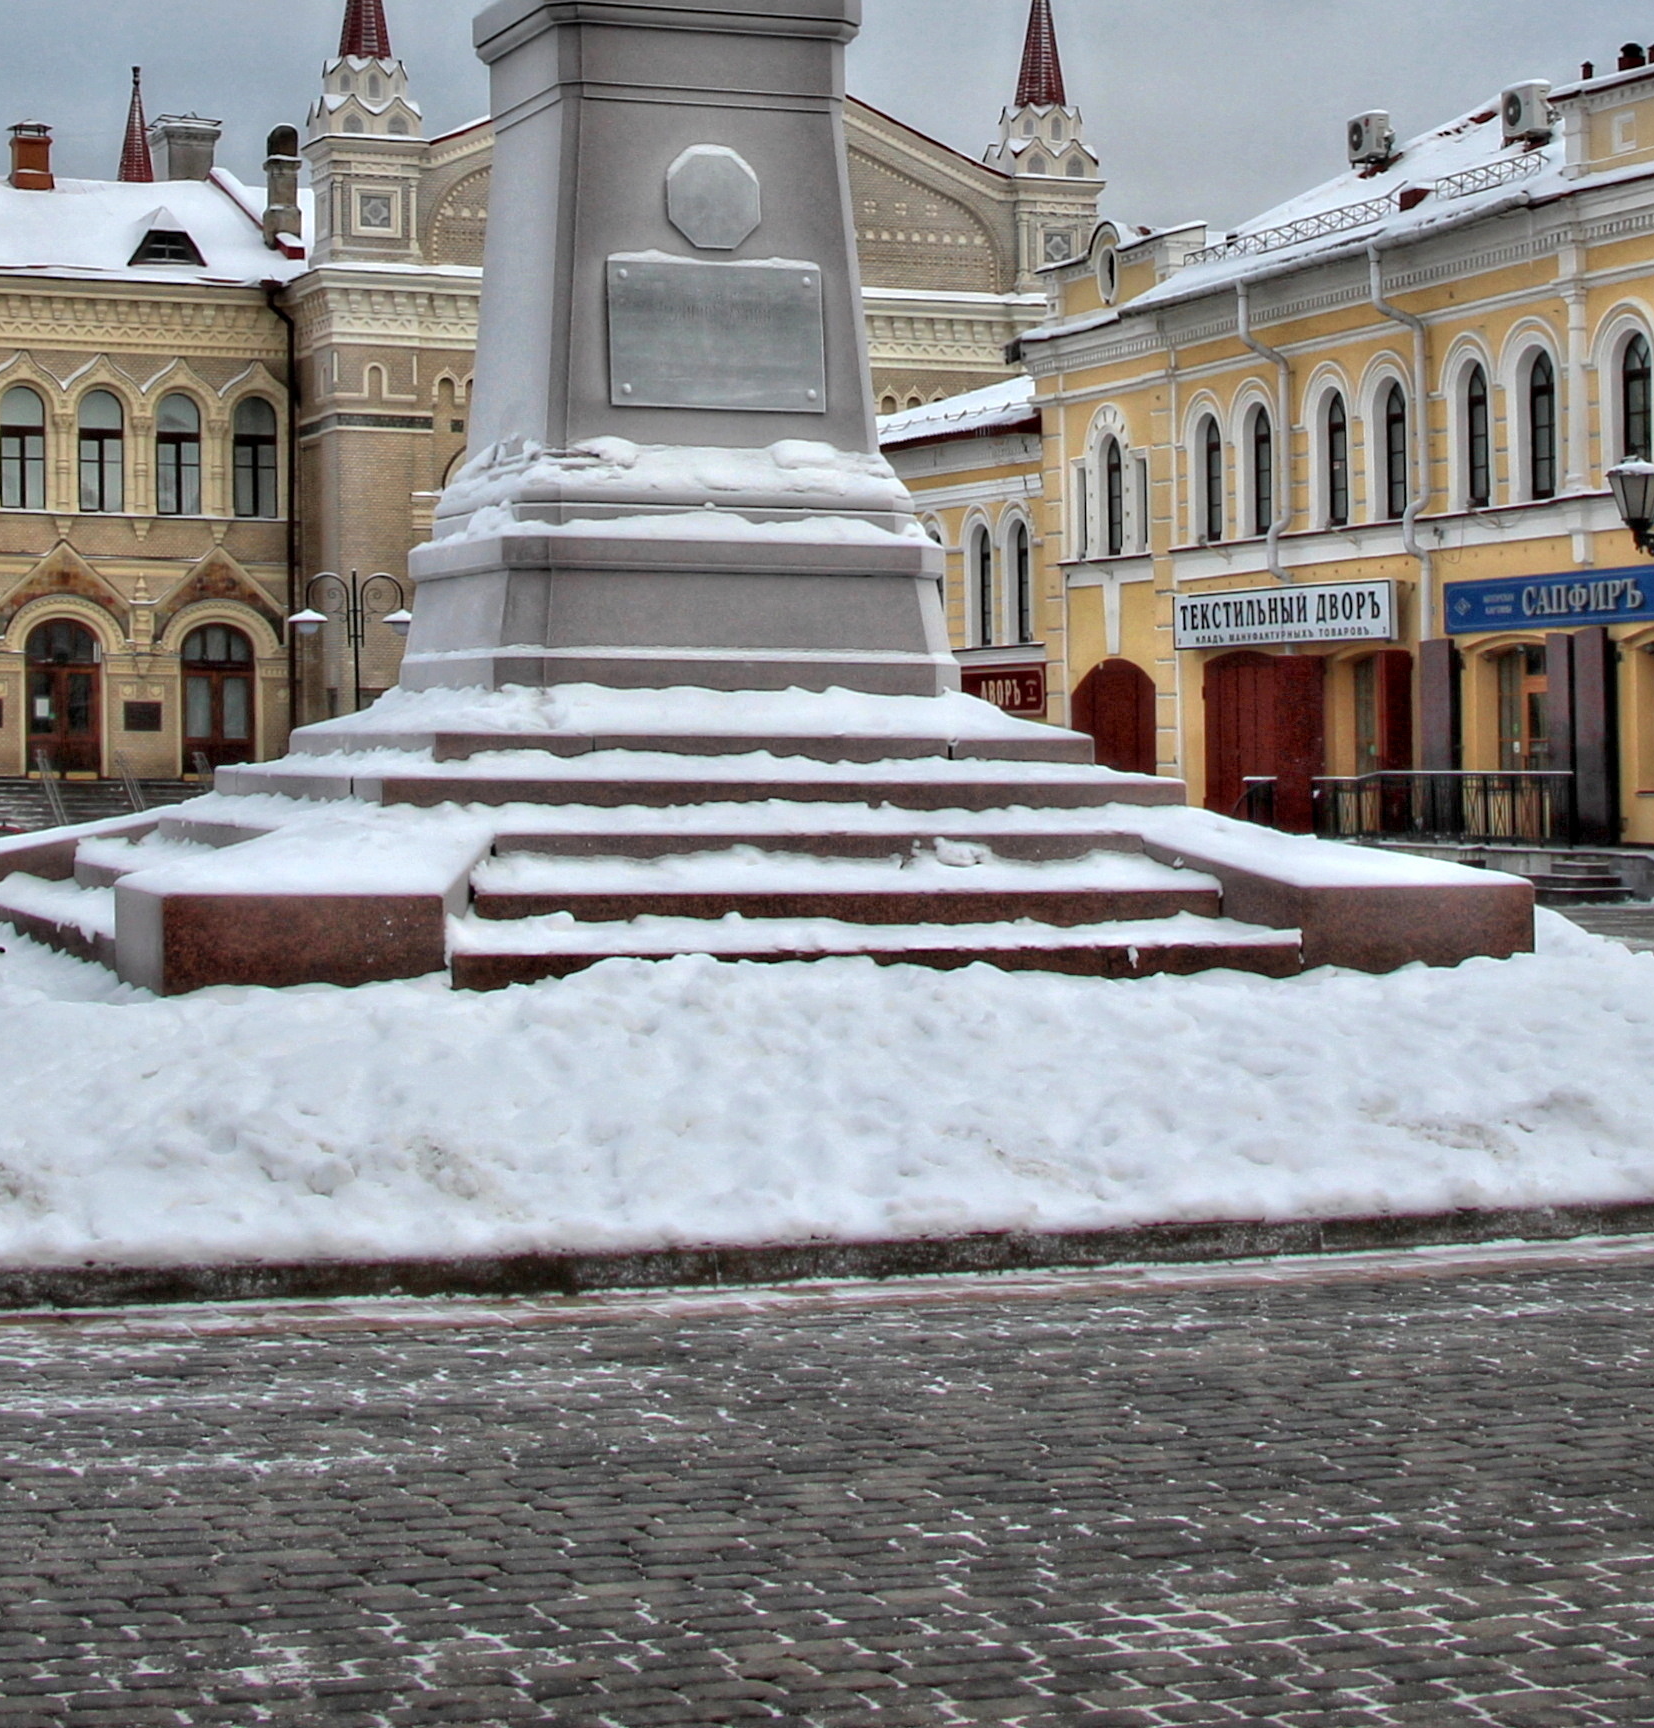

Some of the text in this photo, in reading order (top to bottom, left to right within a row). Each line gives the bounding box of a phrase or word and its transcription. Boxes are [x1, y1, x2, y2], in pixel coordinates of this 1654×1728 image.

[1180, 591, 1381, 631] ТЕКСТИЛЬНЫЙ ДВОРЪ
[1522, 578, 1643, 616] САПФИРЪ
